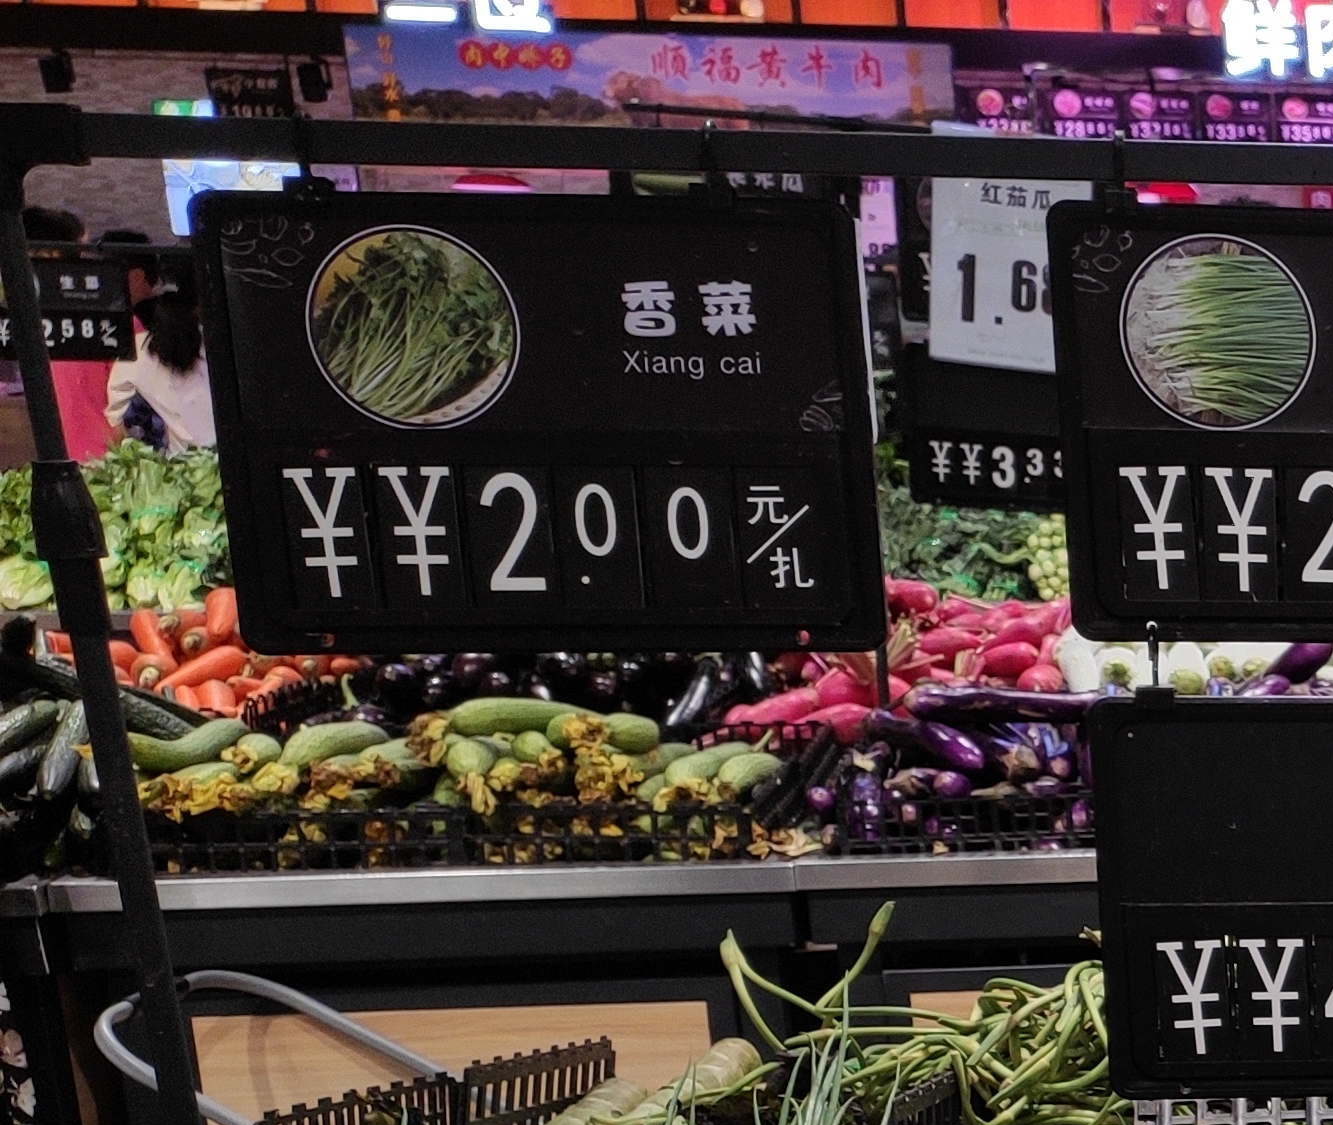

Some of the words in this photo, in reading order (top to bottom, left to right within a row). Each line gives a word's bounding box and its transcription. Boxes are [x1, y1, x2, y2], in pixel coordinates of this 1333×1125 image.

[651, 44, 884, 90] 顺福黄牛肉
[981, 182, 1050, 211] 红茄瓜
[621, 280, 757, 337] 香菜
[623, 350, 704, 380] Xiang
[720, 350, 762, 375] cai
